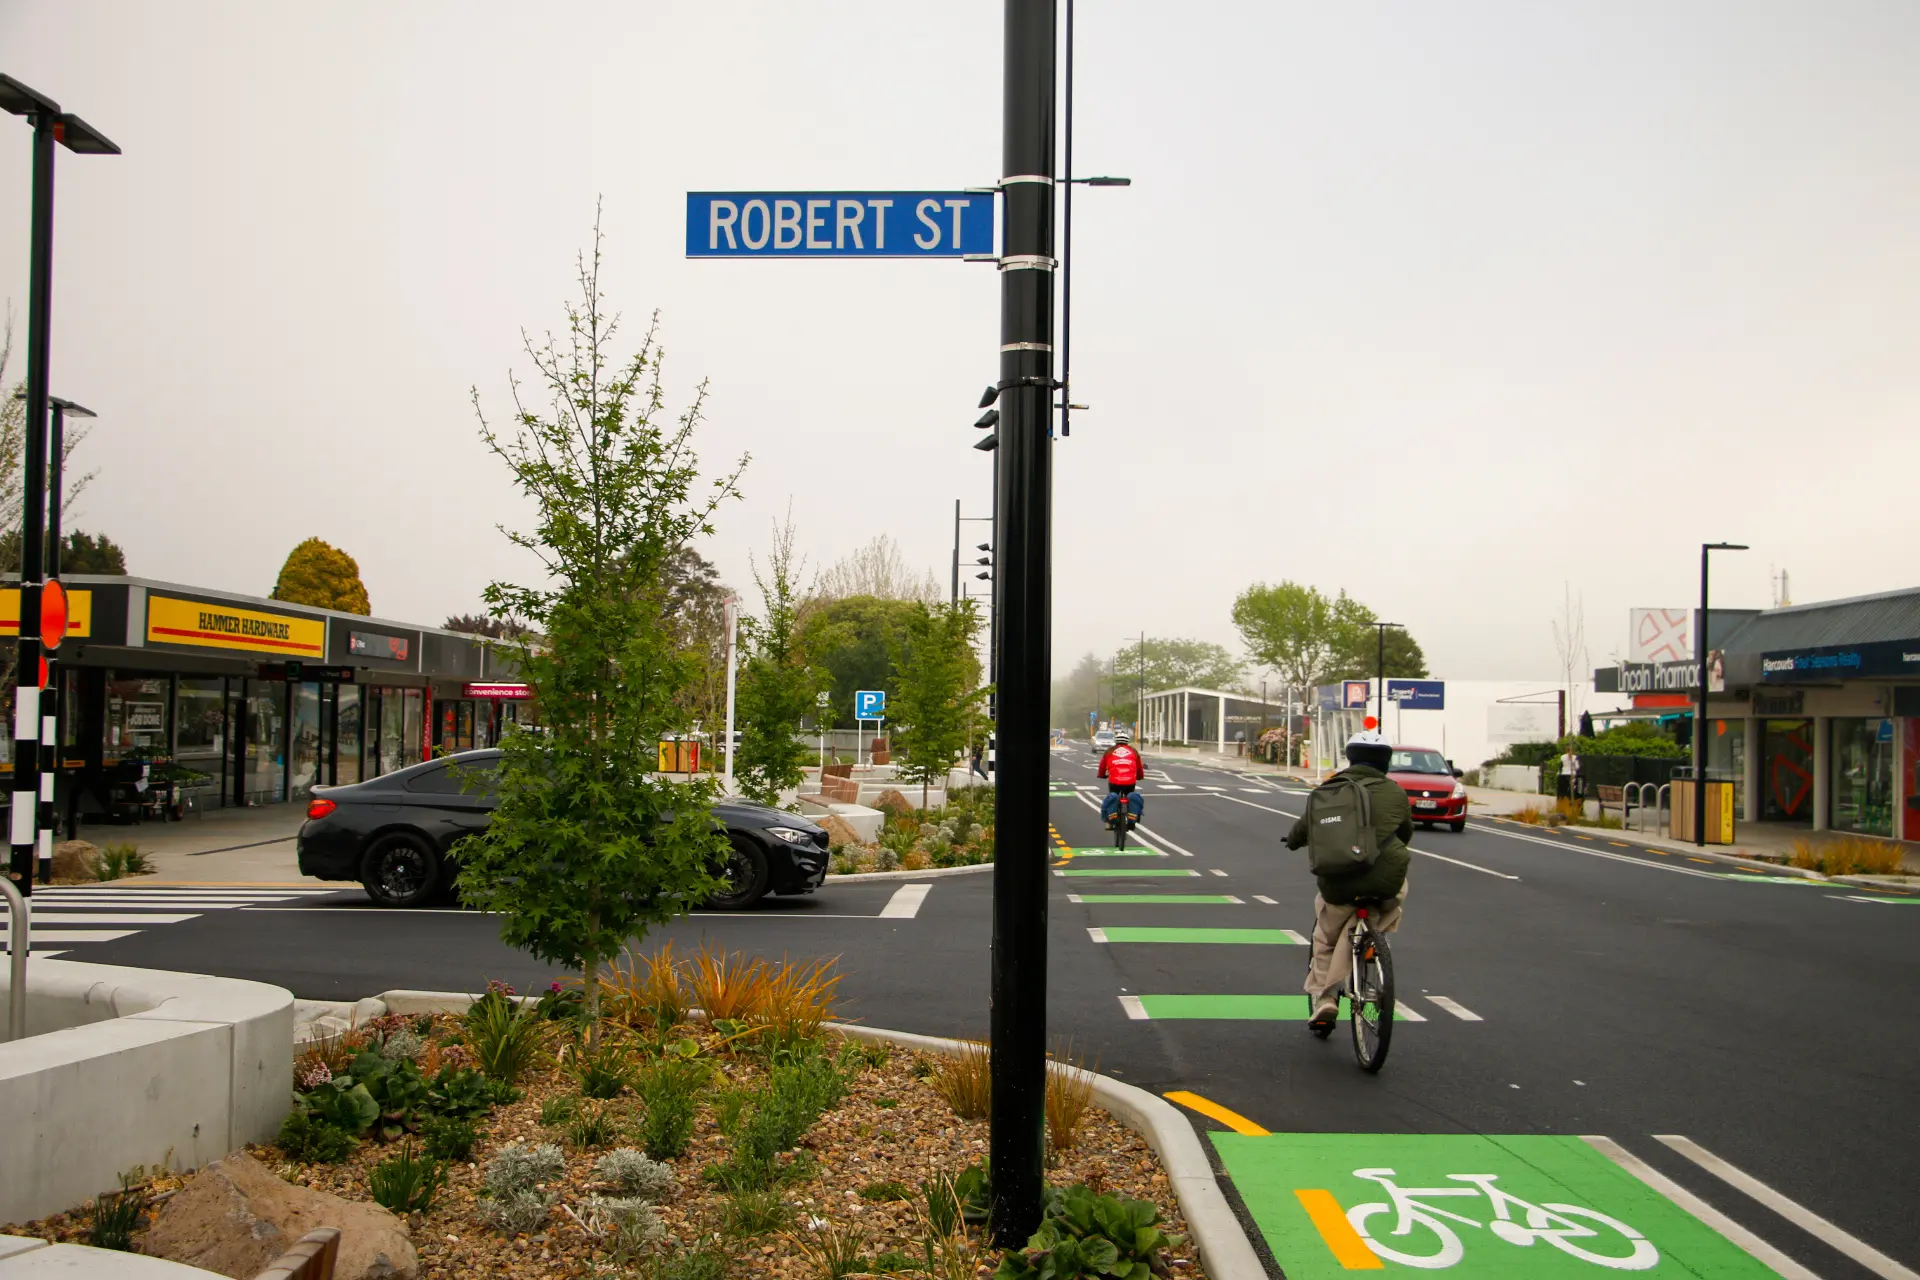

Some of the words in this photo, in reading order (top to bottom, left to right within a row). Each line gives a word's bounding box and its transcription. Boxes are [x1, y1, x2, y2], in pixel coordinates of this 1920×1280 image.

[709, 199, 893, 250] ROBERT
[913, 199, 970, 250] ST
[199, 612, 240, 634] HAMMER
[242, 618, 290, 640] HARDWARE
[1763, 656, 1794, 672] Harcourts
[1617, 663, 1651, 692] Lincoln
[1654, 660, 1701, 690] Pharmac
[514, 688, 531, 697] stor
[863, 694, 877, 710] P
